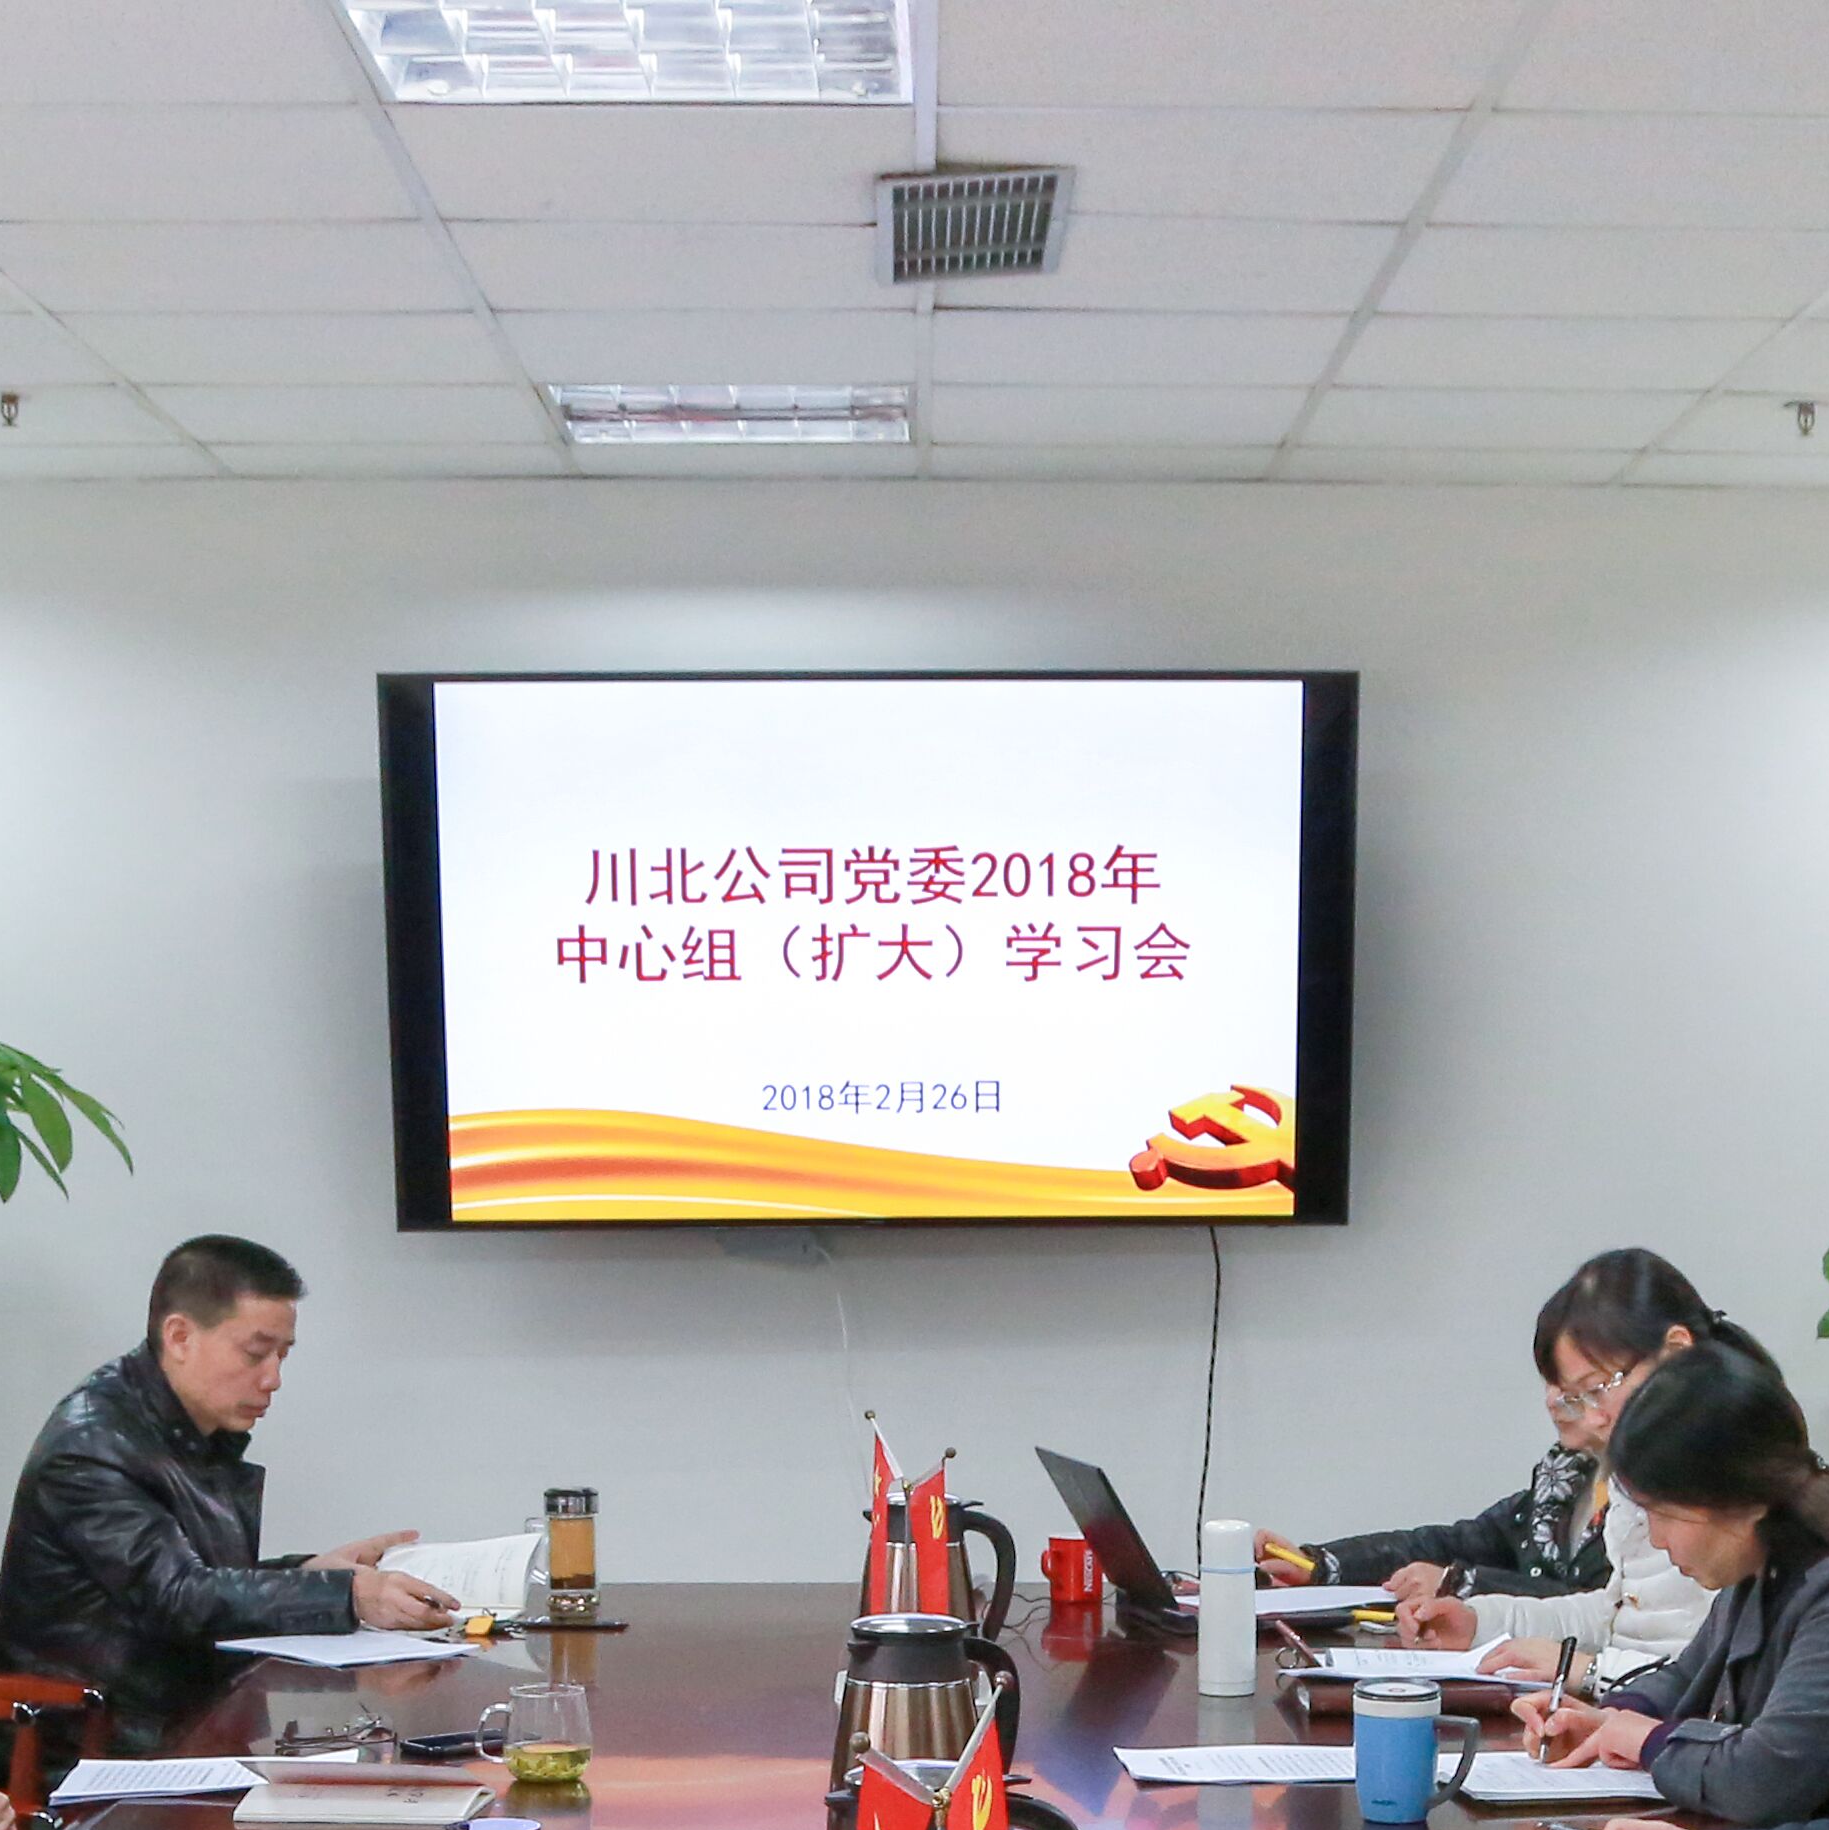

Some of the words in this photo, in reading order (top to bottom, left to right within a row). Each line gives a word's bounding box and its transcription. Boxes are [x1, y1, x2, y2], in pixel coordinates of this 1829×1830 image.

[584, 843, 1162, 907] 川北公司党委2018年
[556, 921, 1191, 985] 中心组（扩大）学习会
[762, 1080, 1000, 1115] 2018年2月26日
[1083, 1549, 1093, 1592] NESCAF
